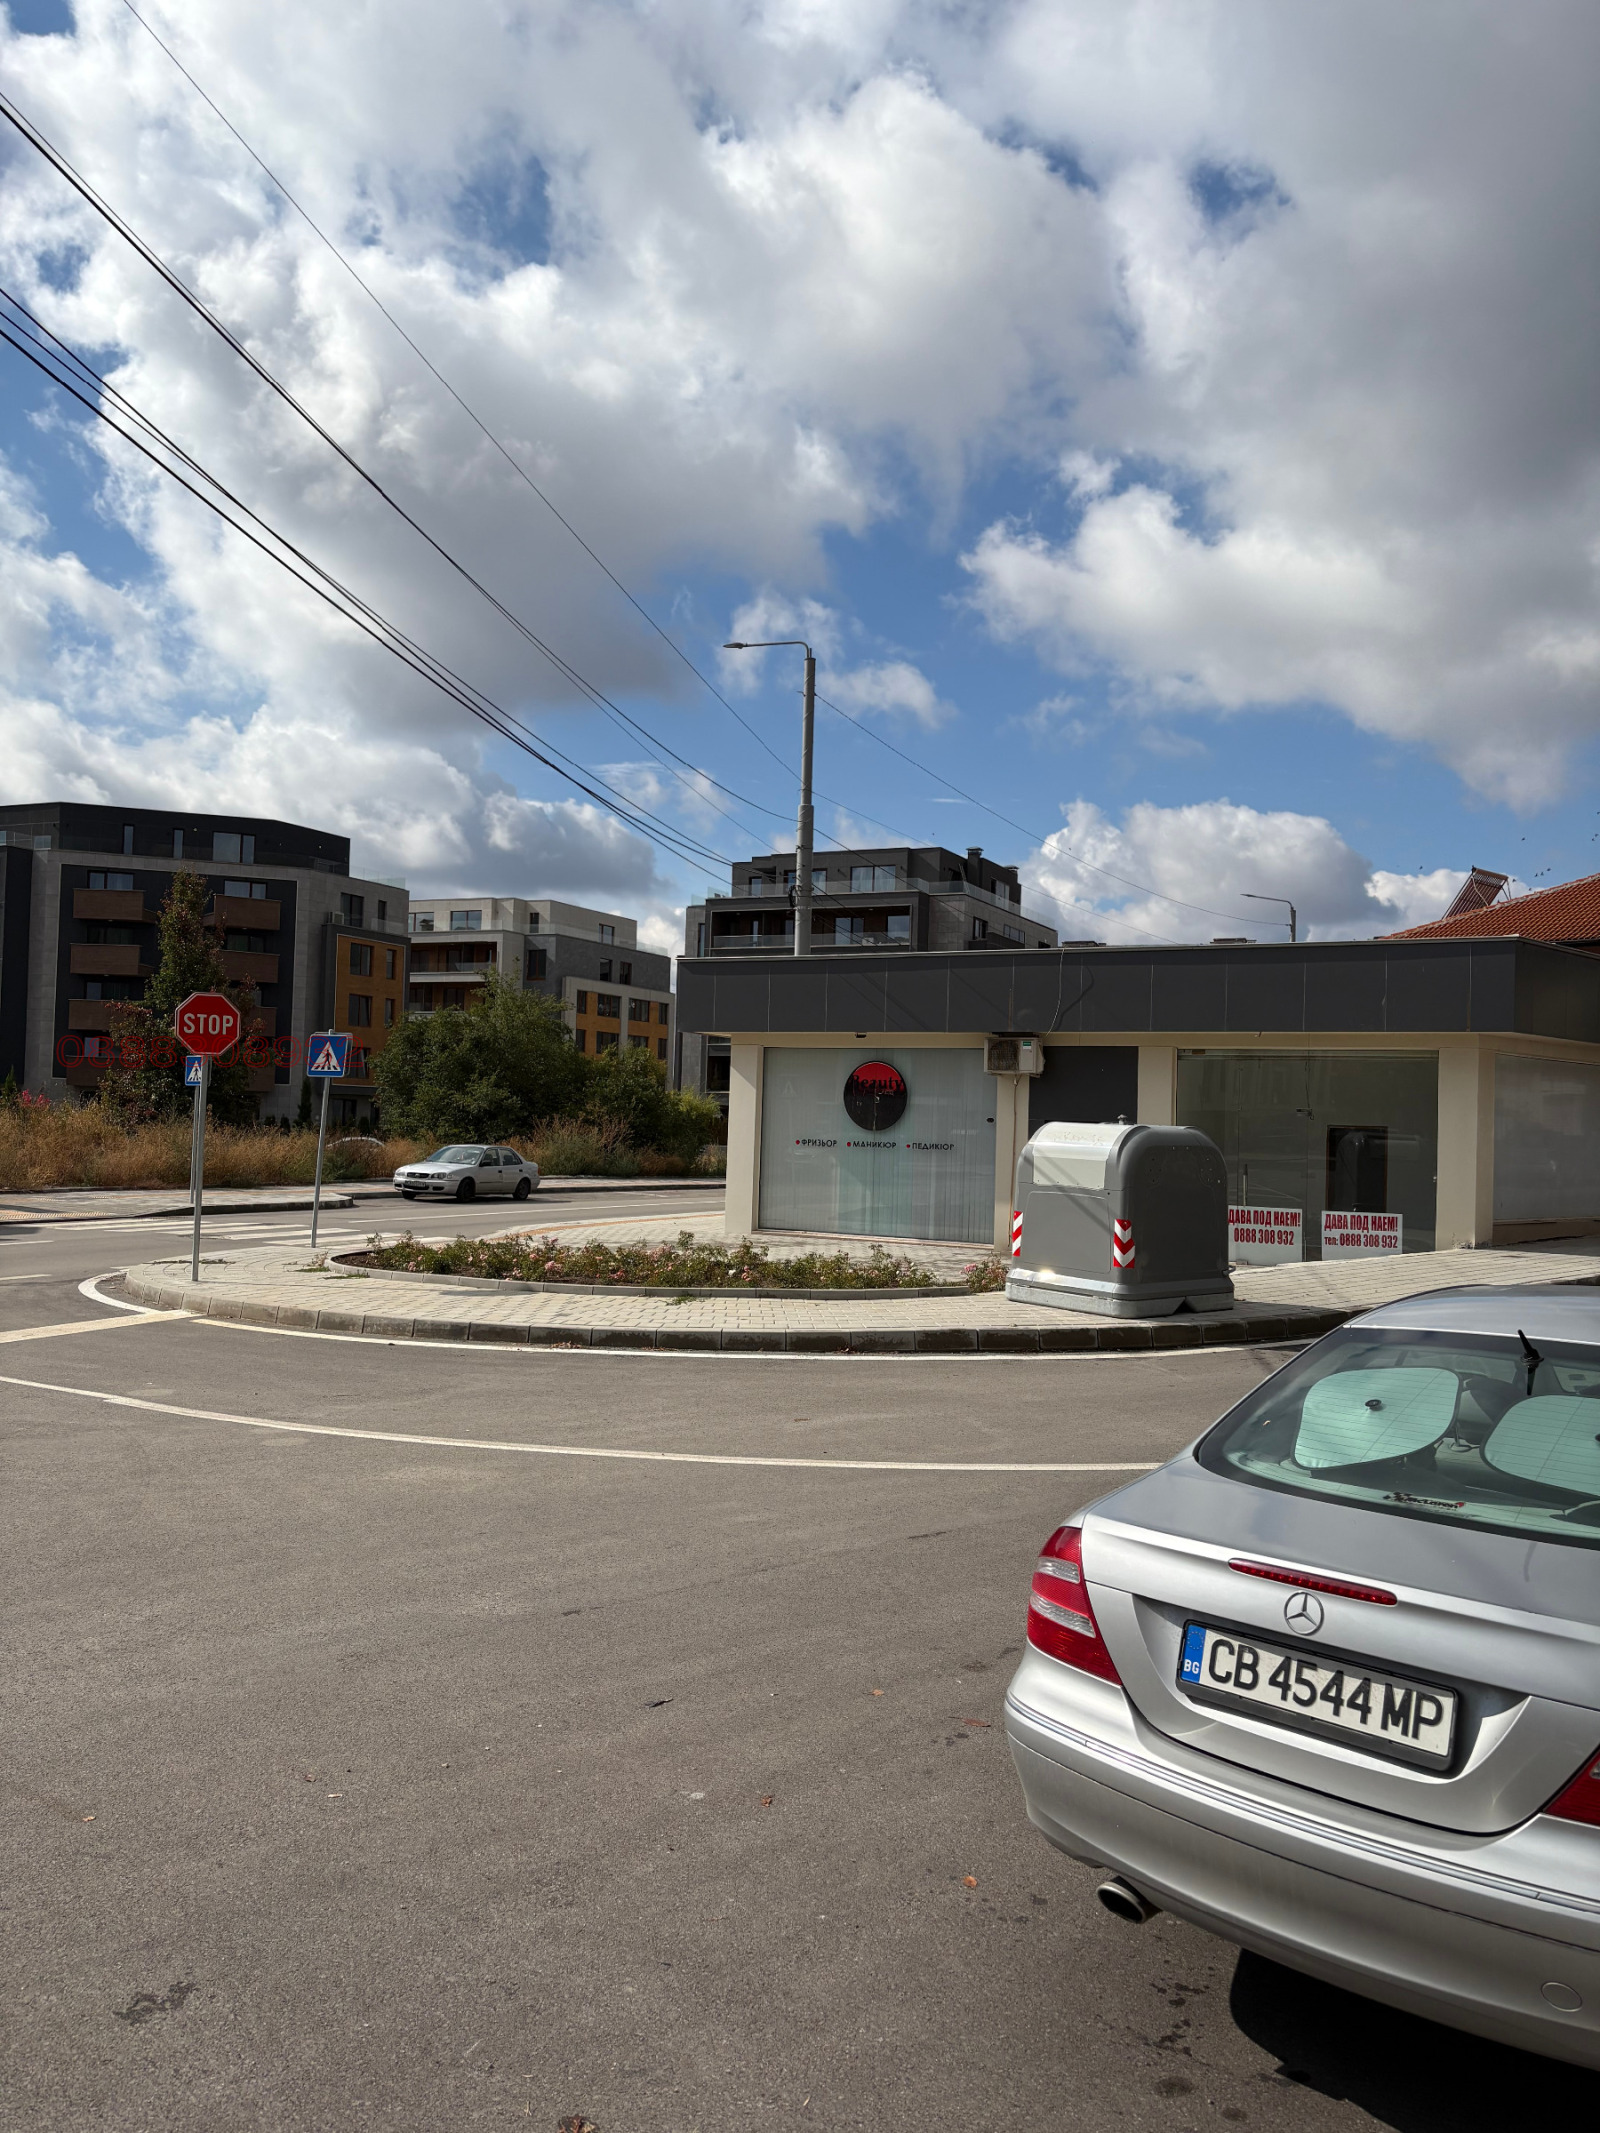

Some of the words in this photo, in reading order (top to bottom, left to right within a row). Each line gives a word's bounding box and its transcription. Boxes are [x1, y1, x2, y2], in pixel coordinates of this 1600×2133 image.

[183, 1012, 234, 1035] STOP
[801, 1139, 838, 1148] ФРИЗЬОР
[852, 1140, 897, 1149] МАНИКЮР
[912, 1142, 955, 1151] ПЕДИКЮР
[1228, 1209, 1252, 1226] ДАВА
[1253, 1210, 1272, 1228] ПОД
[1273, 1211, 1301, 1228] НАЕМ!
[1324, 1214, 1349, 1232] ДАВА
[1350, 1214, 1370, 1233] ПОД
[1371, 1215, 1398, 1233] НАЕМ!
[1234, 1227, 1257, 1243] 0888
[1258, 1229, 1276, 1245] 308
[1277, 1230, 1294, 1246] 932
[1324, 1236, 1338, 1246] тел:
[1339, 1233, 1362, 1247] 0888
[1363, 1234, 1380, 1248] 308
[1381, 1235, 1398, 1249] 932
[1183, 1658, 1200, 1675] BG
[1208, 1638, 1260, 1691] CB
[1268, 1655, 1372, 1725] 4544
[1380, 1682, 1443, 1741] MP
